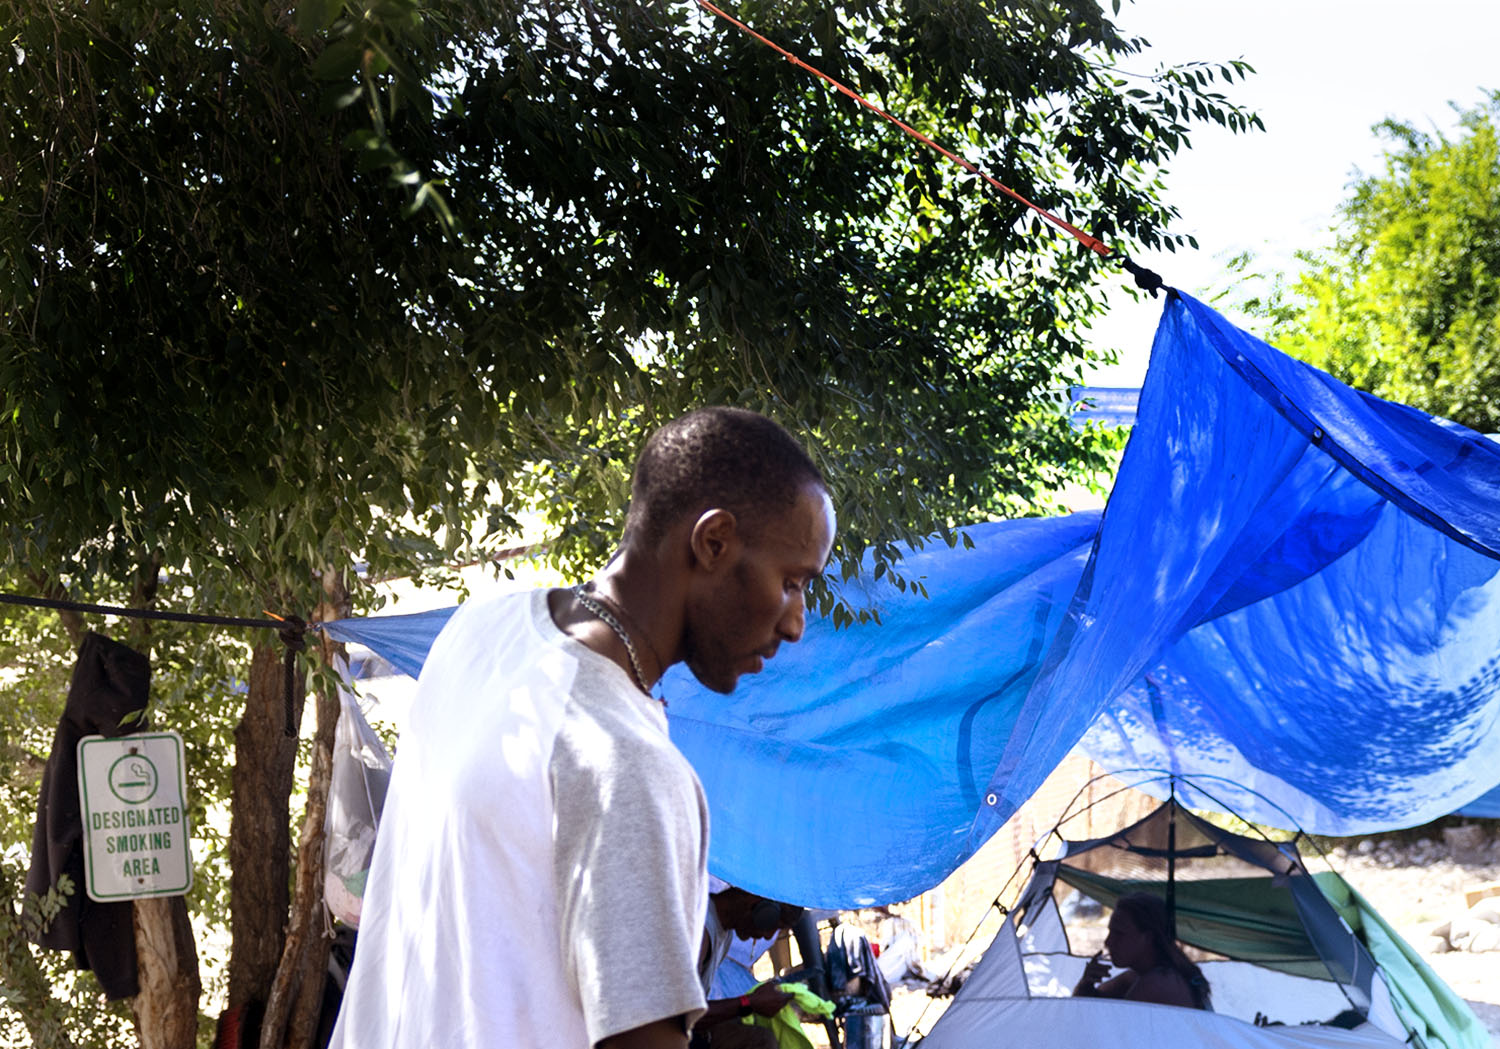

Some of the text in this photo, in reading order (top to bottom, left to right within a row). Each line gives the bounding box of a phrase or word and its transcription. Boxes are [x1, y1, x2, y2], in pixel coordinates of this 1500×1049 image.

[93, 806, 179, 830] DESIGNATED
[106, 832, 172, 854] SMOKING
[123, 858, 160, 878] AREA
